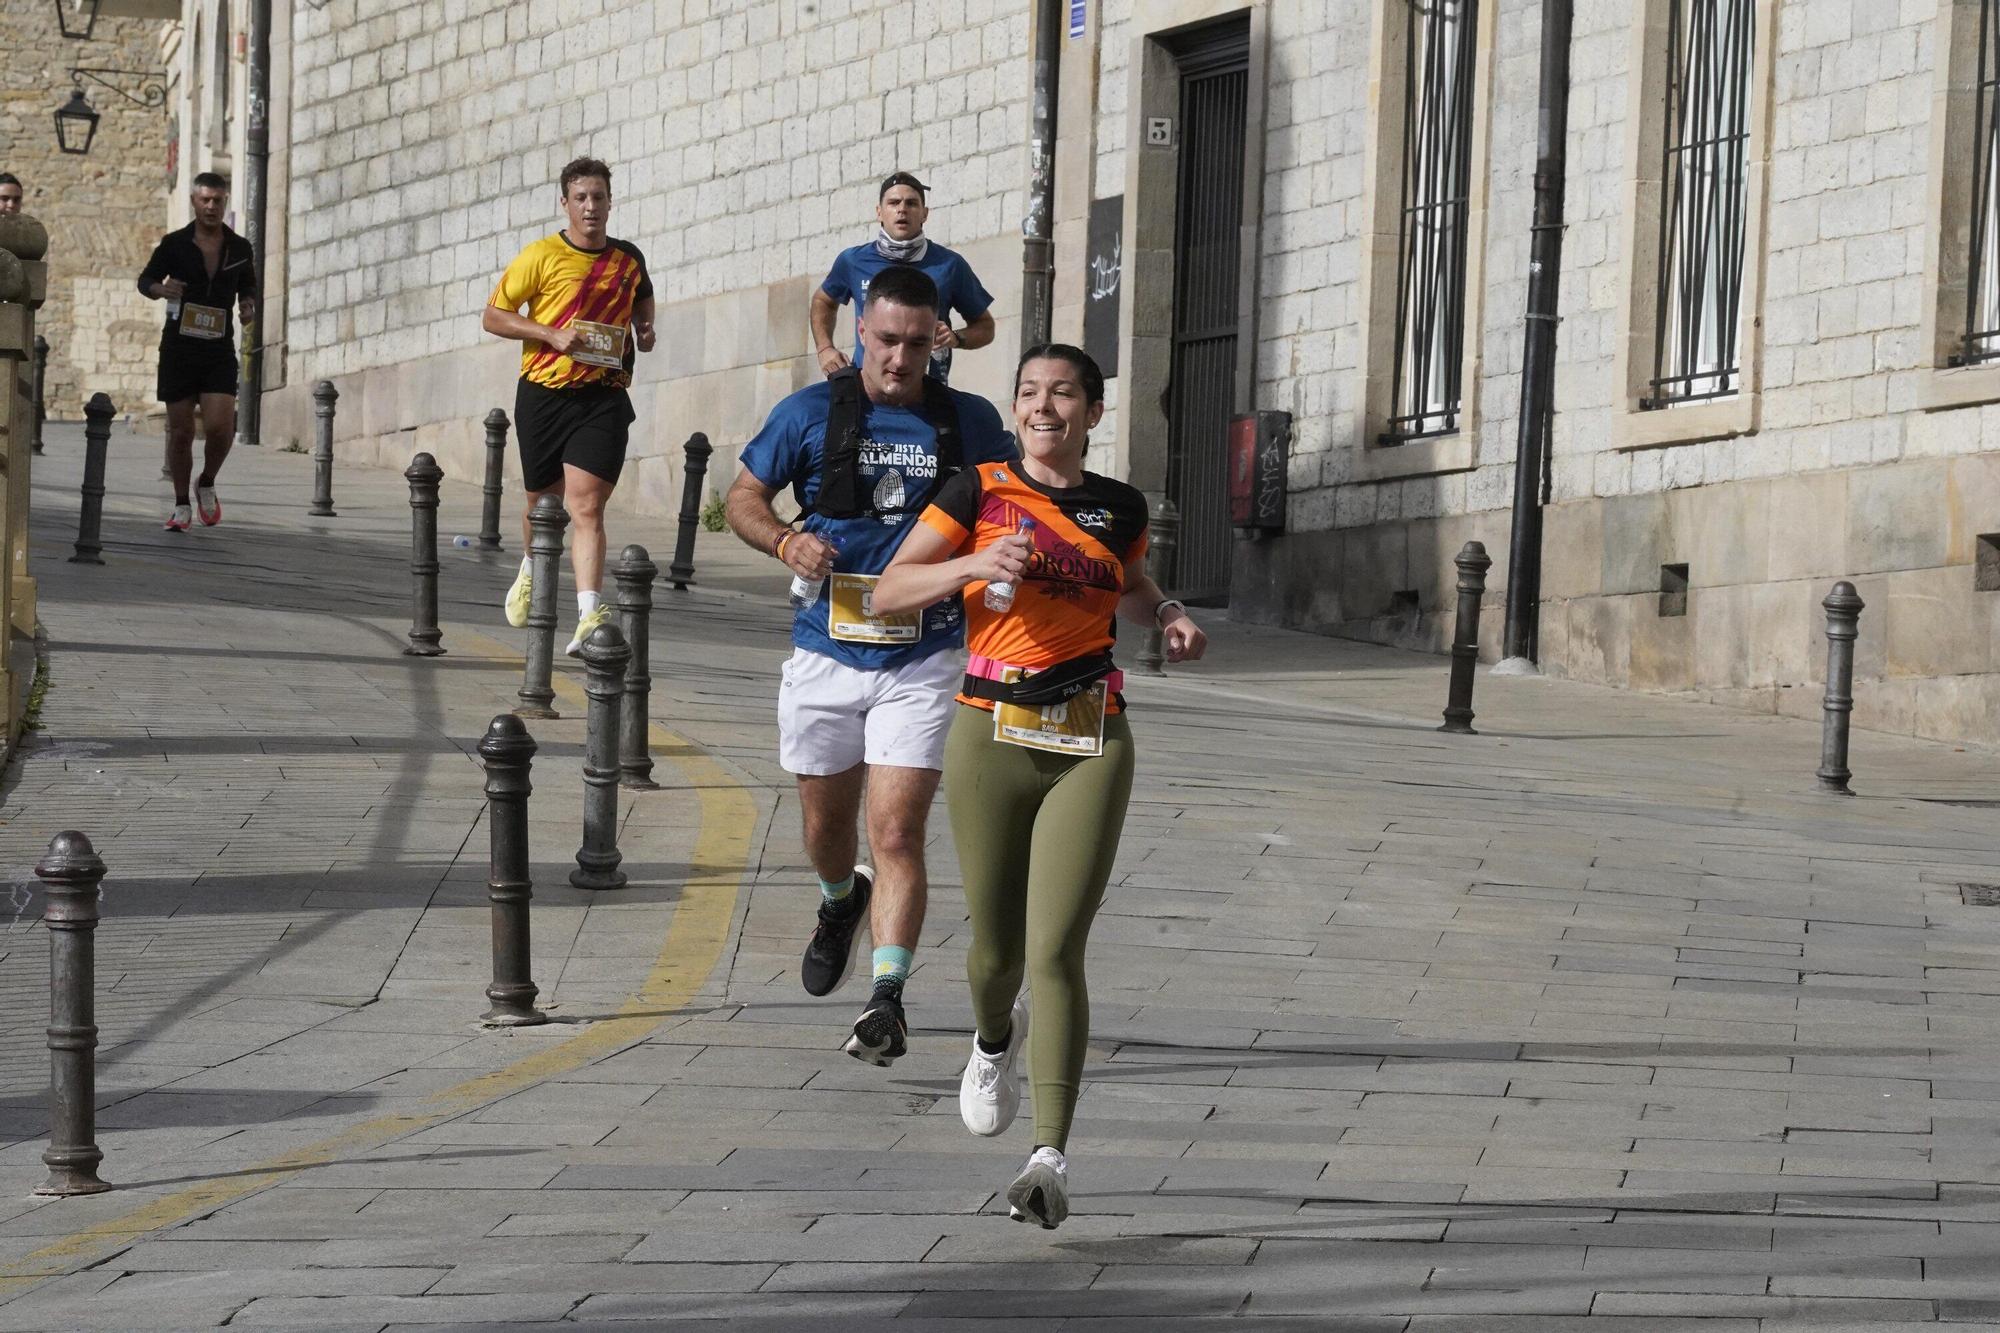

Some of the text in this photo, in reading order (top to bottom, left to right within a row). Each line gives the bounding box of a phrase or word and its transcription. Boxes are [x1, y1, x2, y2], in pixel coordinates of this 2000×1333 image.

[1152, 122, 1166, 140] 3
[194, 313, 215, 328] 691
[858, 451, 938, 467] ALMENDR
[1027, 552, 1120, 584] ORONDA
[862, 591, 877, 617] 9
[1063, 684, 1082, 697] FILA
